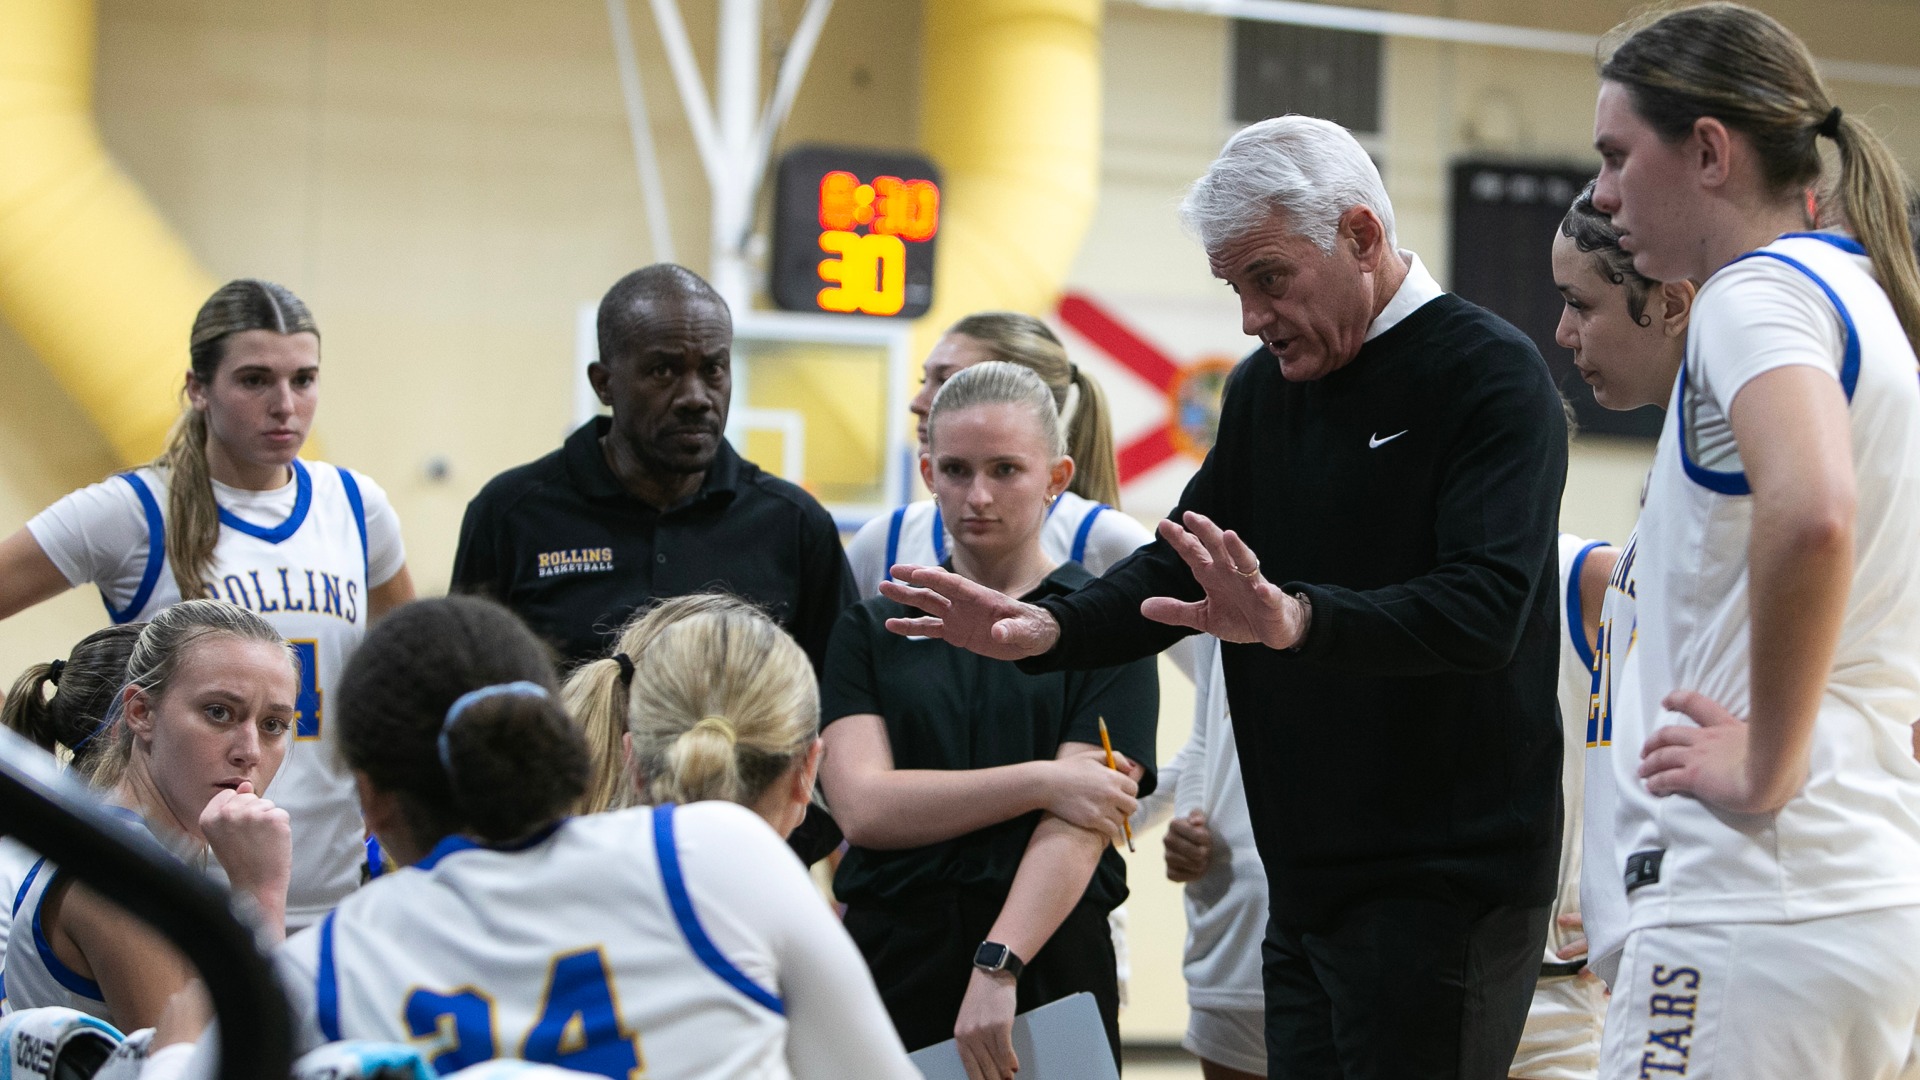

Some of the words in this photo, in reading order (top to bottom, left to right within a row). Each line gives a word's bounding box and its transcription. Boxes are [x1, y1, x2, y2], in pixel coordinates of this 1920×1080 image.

[817, 230, 906, 316] 30
[538, 547, 613, 567] ROLLINS
[538, 562, 614, 577] BASKETBALL
[400, 943, 645, 1080] 24
